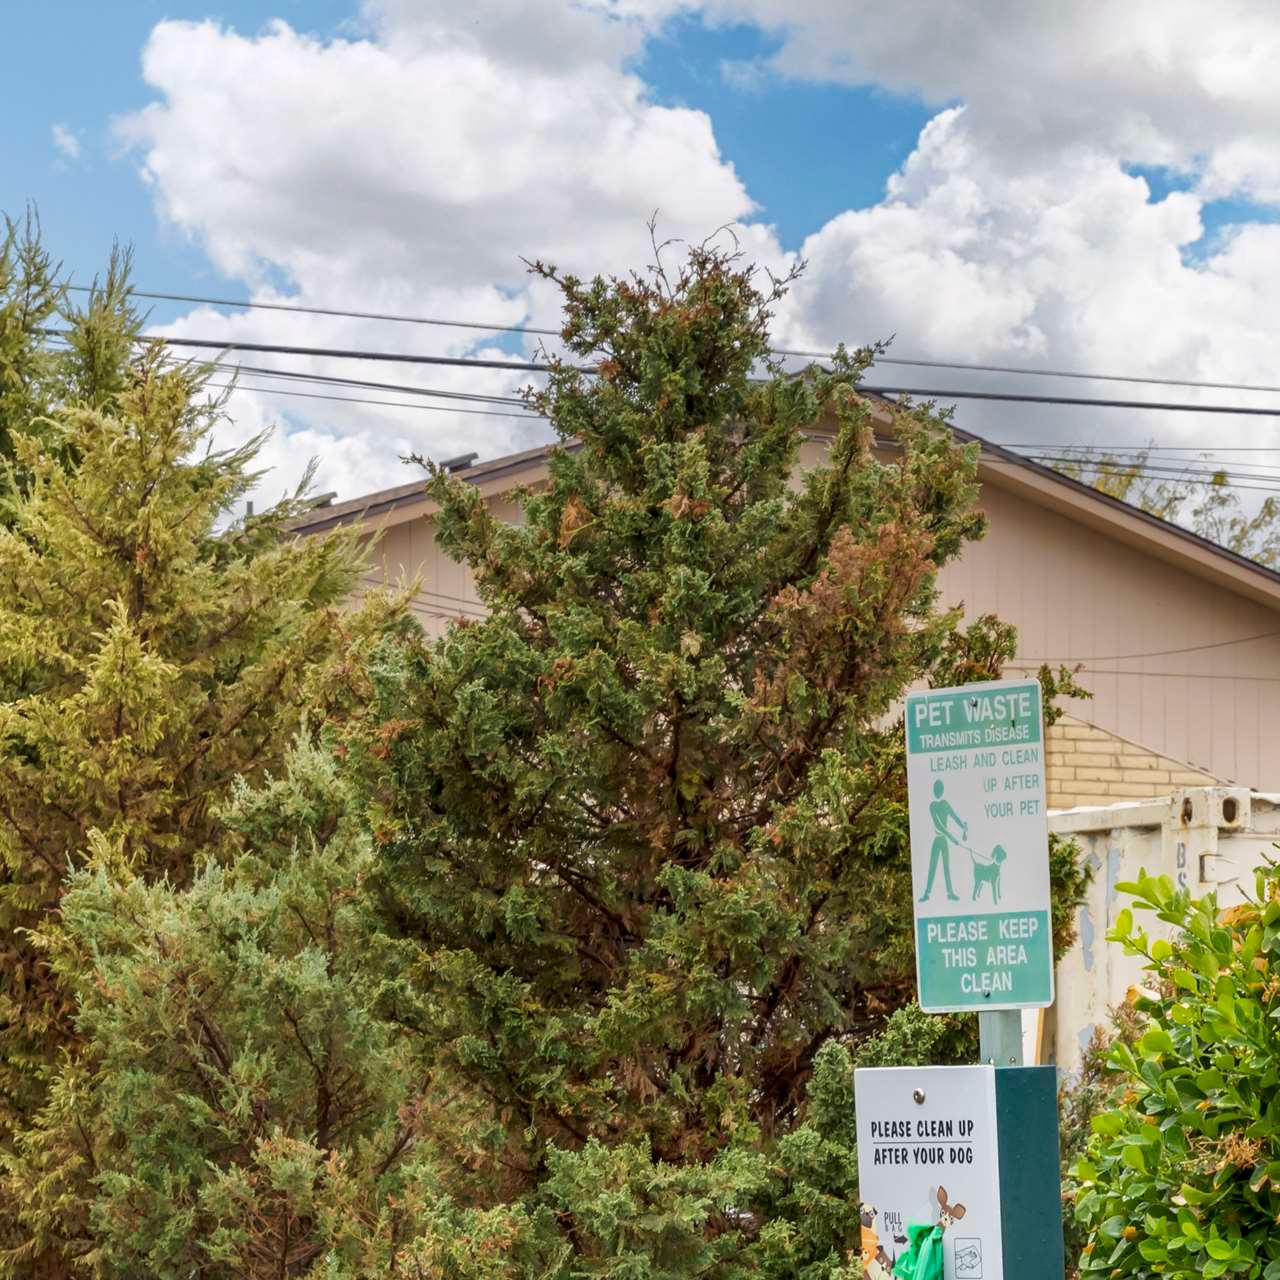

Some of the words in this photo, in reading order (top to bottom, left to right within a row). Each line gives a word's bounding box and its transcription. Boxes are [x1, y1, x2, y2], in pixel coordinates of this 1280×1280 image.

[915, 700, 954, 728] PET
[963, 692, 1032, 723] WASTE
[919, 729, 981, 749] TRANSMITS
[984, 724, 1030, 743] DISEASE
[930, 755, 967, 772] LEASH
[973, 752, 997, 768] AND
[1001, 748, 1039, 766] CLEAN
[983, 777, 997, 793] UP
[1003, 774, 1040, 791] AFTER
[984, 801, 1014, 818] YOUR
[1020, 800, 1040, 816] PET
[927, 921, 988, 944] PLEASE
[999, 917, 1039, 939] KEEP
[942, 947, 977, 969] THIS
[986, 944, 1028, 966] AREA
[960, 971, 1013, 993] CLEAN
[871, 1120, 912, 1138] PLEASE
[916, 1119, 953, 1137] CLEAN
[959, 1119, 974, 1136] UP
[874, 1147, 909, 1165] AFTER
[913, 1146, 945, 1165] YOUR
[949, 1146, 973, 1164] DOG
[884, 1211, 902, 1225] PULL
